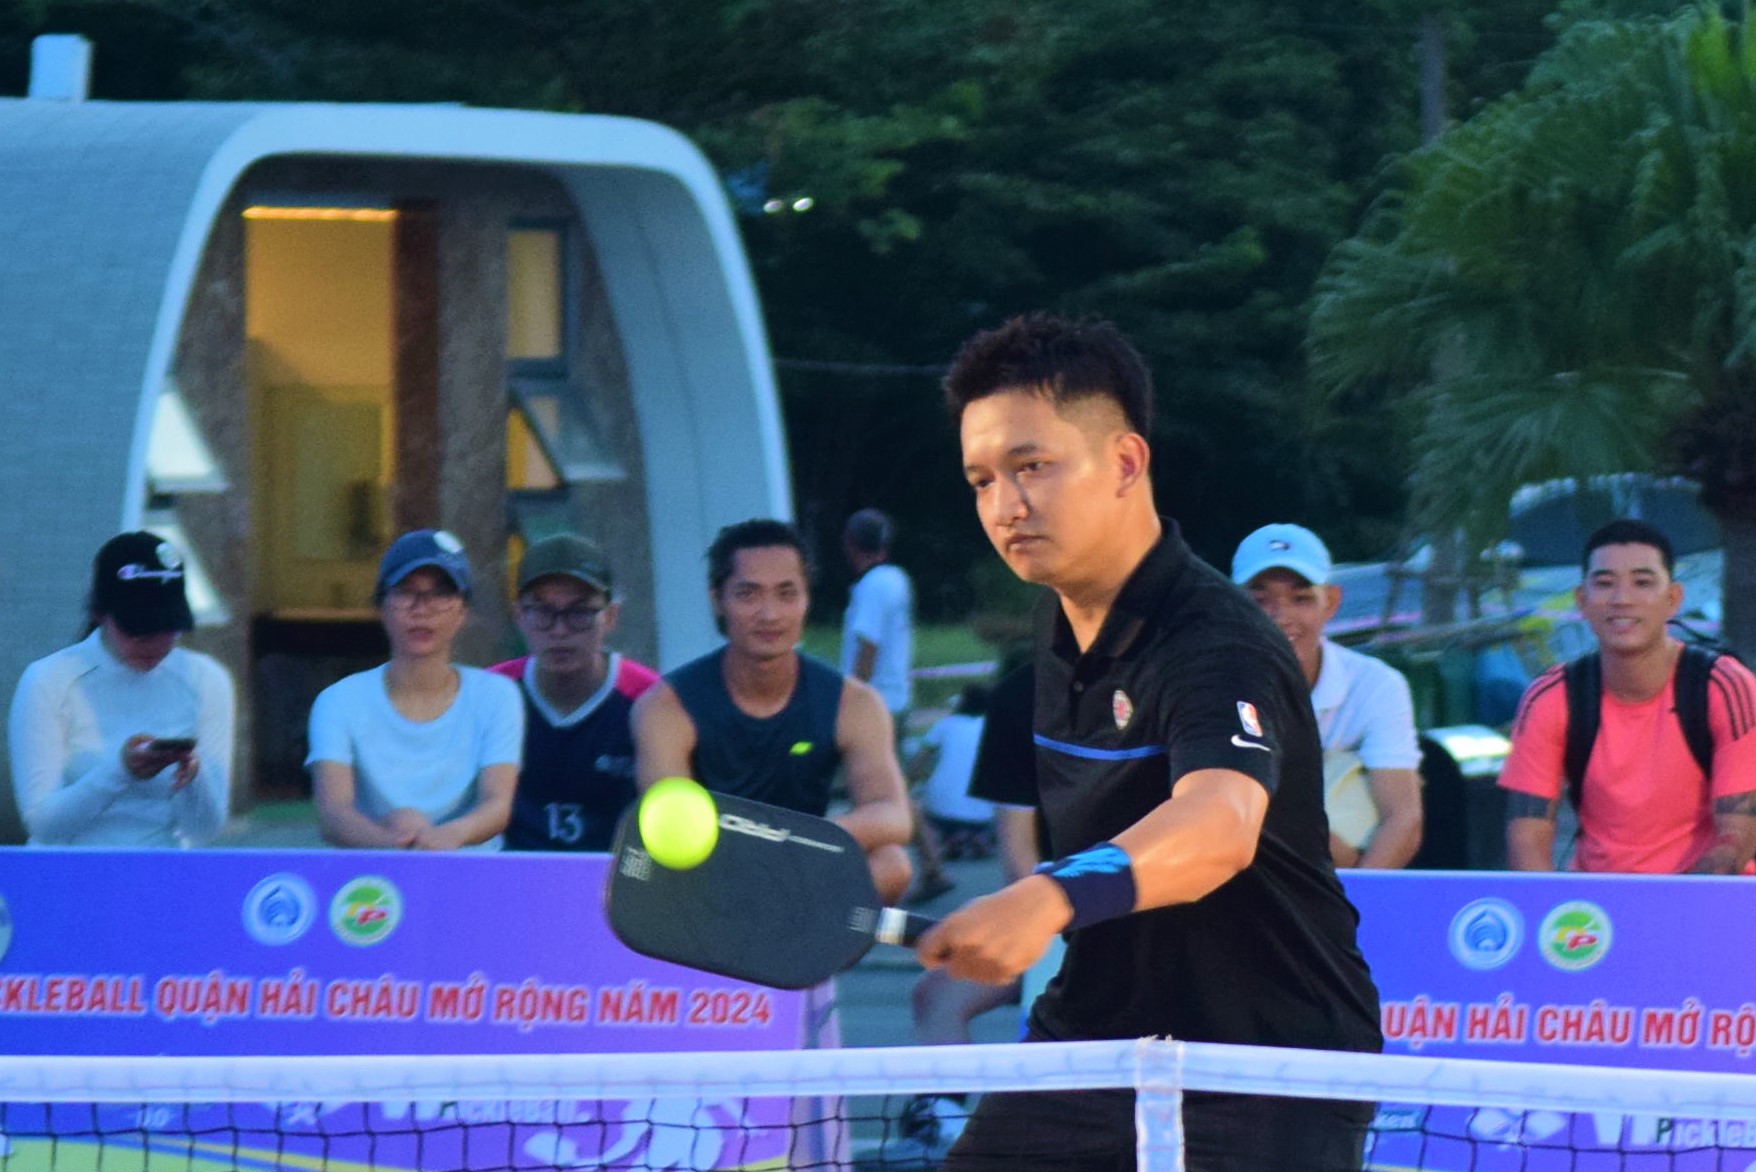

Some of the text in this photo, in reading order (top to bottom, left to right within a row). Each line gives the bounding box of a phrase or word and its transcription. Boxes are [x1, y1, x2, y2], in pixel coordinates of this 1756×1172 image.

[0, 968, 772, 1031] KLEBALL QUẬN HẢI CHÂU MỞ RỘNG NĂM 2024
[1382, 996, 1456, 1047] UẬN
[1468, 992, 1525, 1043] HẢI
[1538, 998, 1631, 1047] CHÂU
[1644, 994, 1700, 1048] MỞ
